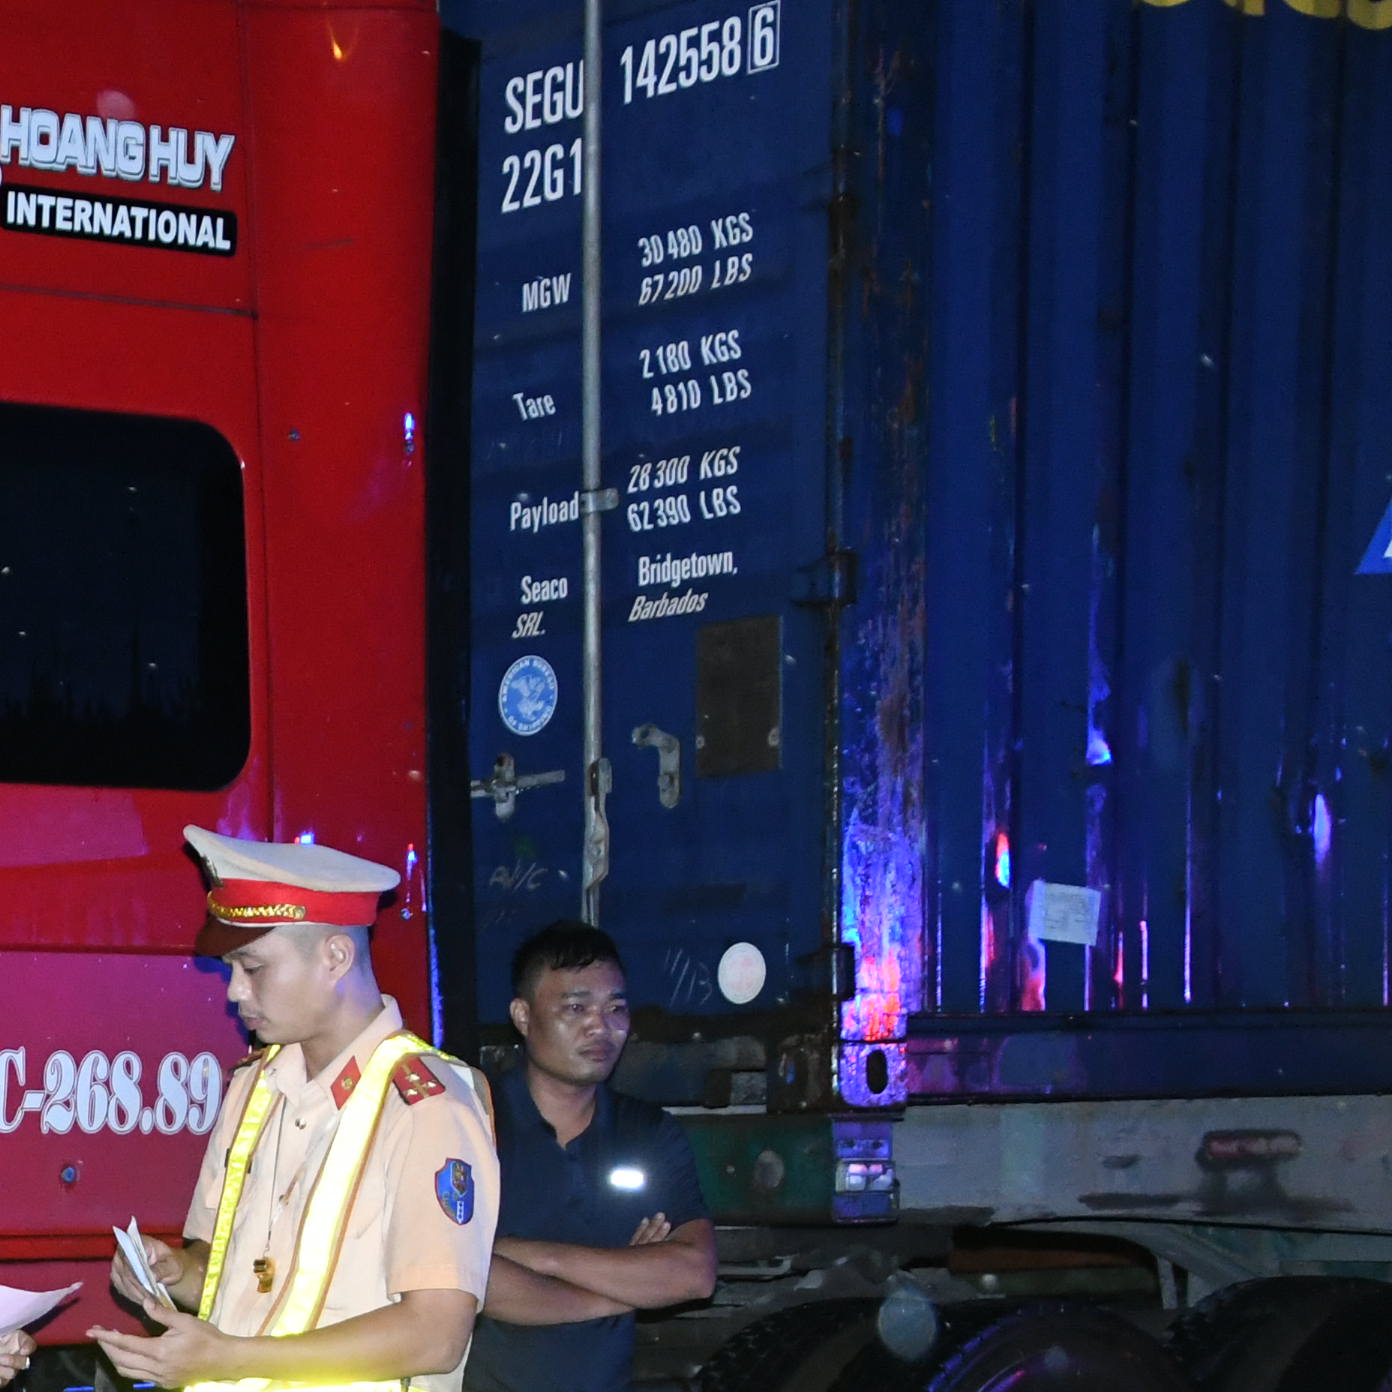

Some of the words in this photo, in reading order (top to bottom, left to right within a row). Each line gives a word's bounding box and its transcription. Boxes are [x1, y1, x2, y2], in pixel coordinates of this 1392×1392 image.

[504, 59, 584, 134] SEGU
[620, 15, 742, 104] 142558
[753, 6, 775, 66] 6
[0, 104, 146, 182] HOANG
[148, 125, 236, 192] HUY
[501, 137, 583, 213] 22G1
[6, 190, 232, 251] INTERNATIONAL
[711, 211, 753, 250] KGS
[711, 253, 753, 290] LBS
[522, 273, 572, 313] MGW
[700, 329, 742, 366] KGS
[710, 368, 752, 405] LBS
[512, 392, 557, 421] Tare
[699, 446, 741, 480] KGS
[510, 492, 579, 534] Payload
[699, 485, 741, 519] LBS
[638, 551, 738, 587] Bridgetown,
[520, 575, 568, 604] Seaco
[628, 591, 709, 622] Barbados
